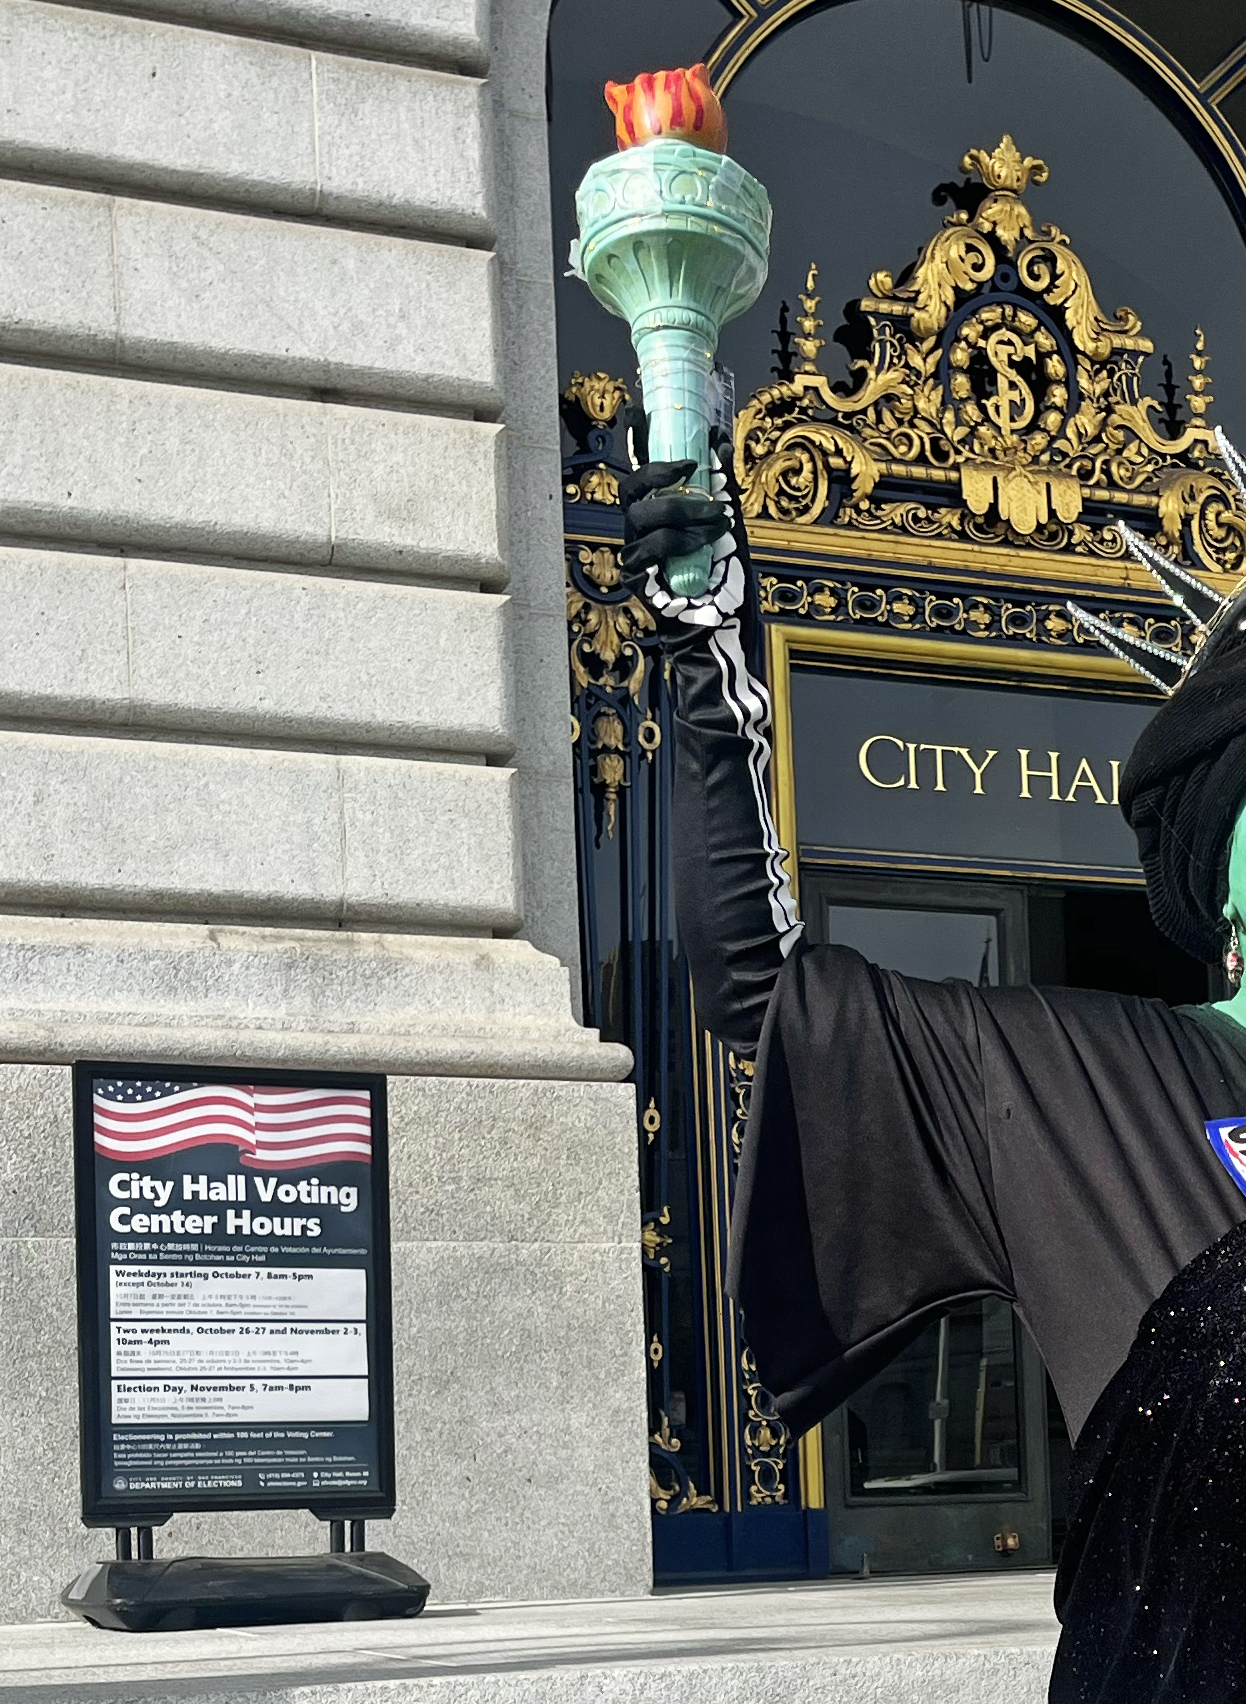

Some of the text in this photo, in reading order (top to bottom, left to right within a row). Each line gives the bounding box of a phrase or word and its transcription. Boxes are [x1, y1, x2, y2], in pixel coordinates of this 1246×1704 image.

[858, 735, 998, 795] CITY
[109, 1172, 358, 1212] City Hall Voting
[109, 1206, 322, 1237] Center Hours
[115, 1269, 167, 1280] Weekdays
[170, 1270, 209, 1281] starting
[211, 1271, 252, 1279] October
[116, 1326, 138, 1334] Two
[141, 1326, 193, 1336] weekends,
[196, 1327, 236, 1335] October
[239, 1327, 266, 1335] 26-27
[269, 1327, 287, 1335] and
[290, 1327, 340, 1335] November
[116, 1338, 170, 1347] 10am-4pm
[117, 1384, 160, 1393] Election
[163, 1384, 187, 1395] Day,
[190, 1383, 246, 1392] November
[262, 1383, 312, 1393] 7am-8pm
[129, 1481, 183, 1490] DEPARTMENT
[184, 1480, 196, 1488] OF
